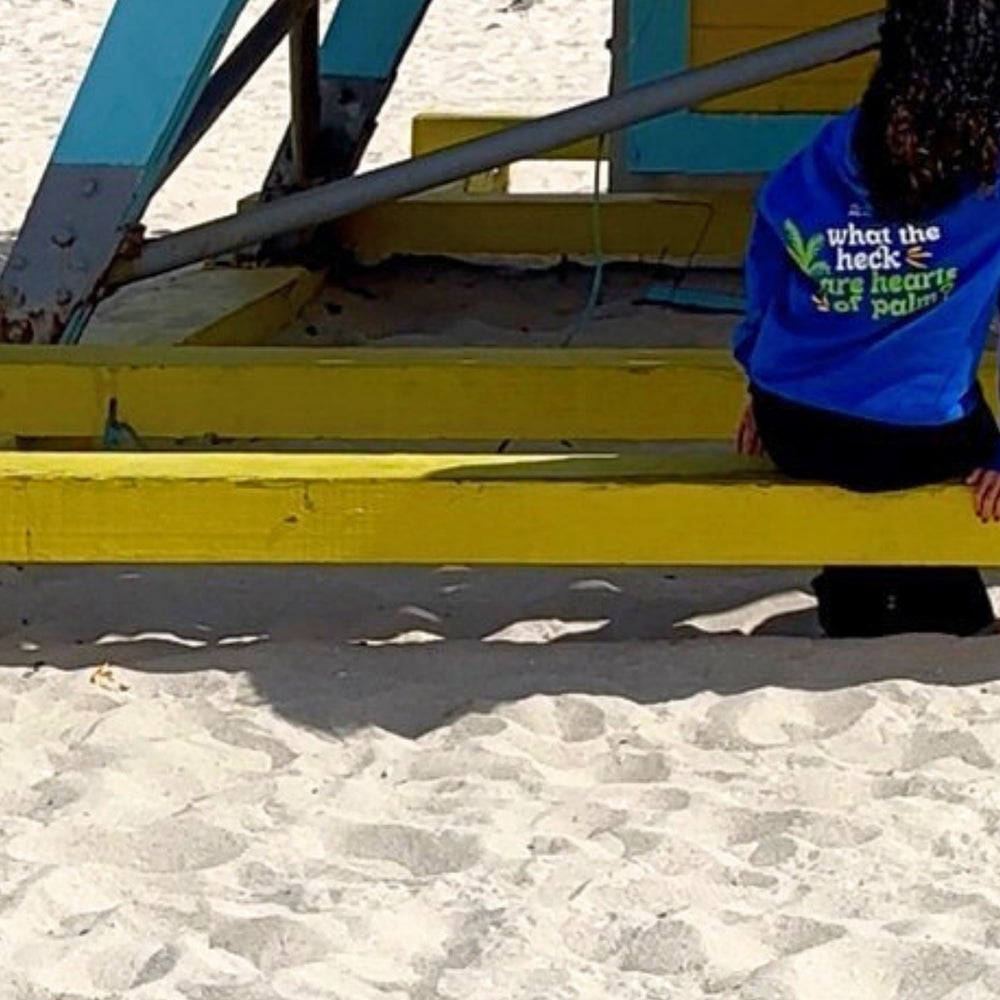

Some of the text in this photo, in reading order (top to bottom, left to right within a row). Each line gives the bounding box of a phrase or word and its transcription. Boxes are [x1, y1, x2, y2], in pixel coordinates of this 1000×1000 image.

[826, 222, 941, 247] what the
[835, 246, 901, 271] heck
[820, 266, 959, 296] are hearts
[832, 295, 863, 313] of
